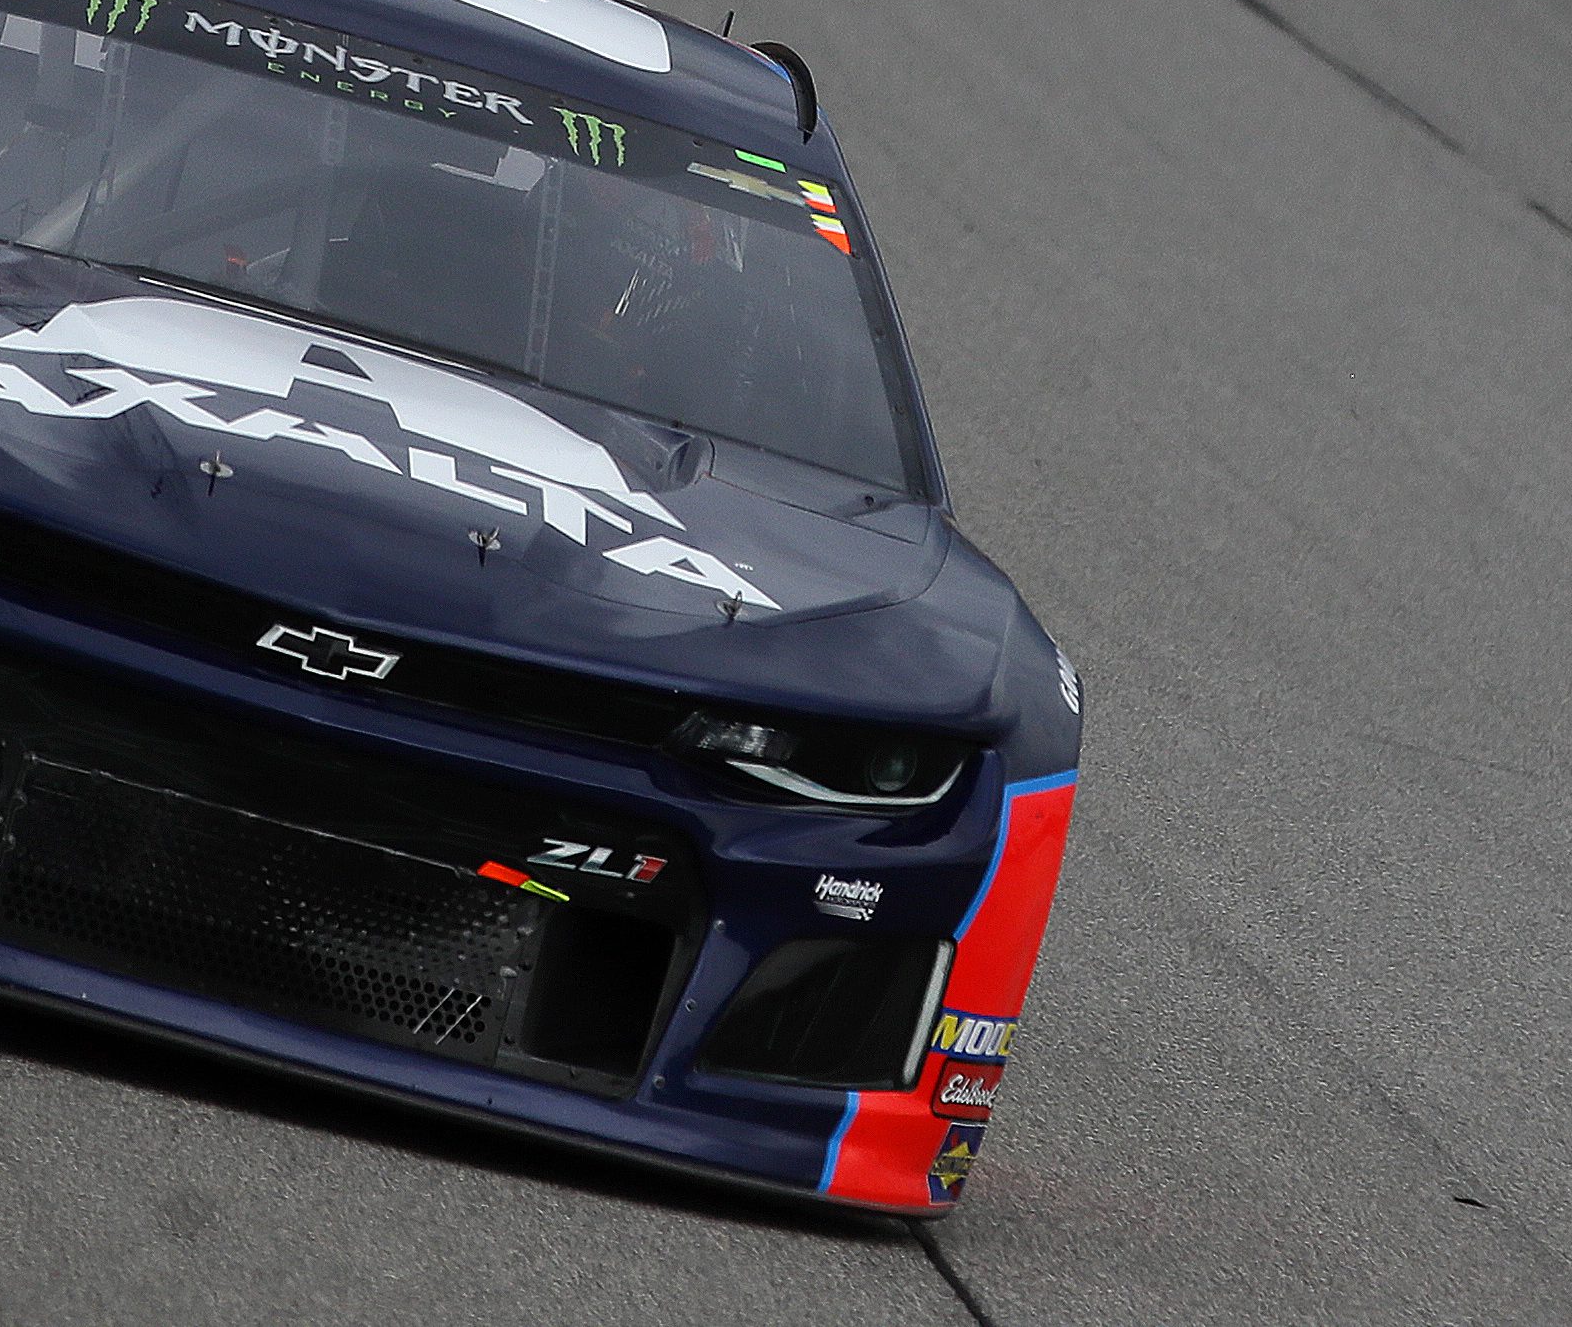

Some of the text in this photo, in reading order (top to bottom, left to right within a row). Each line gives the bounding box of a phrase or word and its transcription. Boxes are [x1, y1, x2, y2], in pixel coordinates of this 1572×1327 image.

[184, 10, 534, 126] MONSTER
[267, 61, 457, 119] ENERGY
[814, 874, 884, 903] Hendrick
